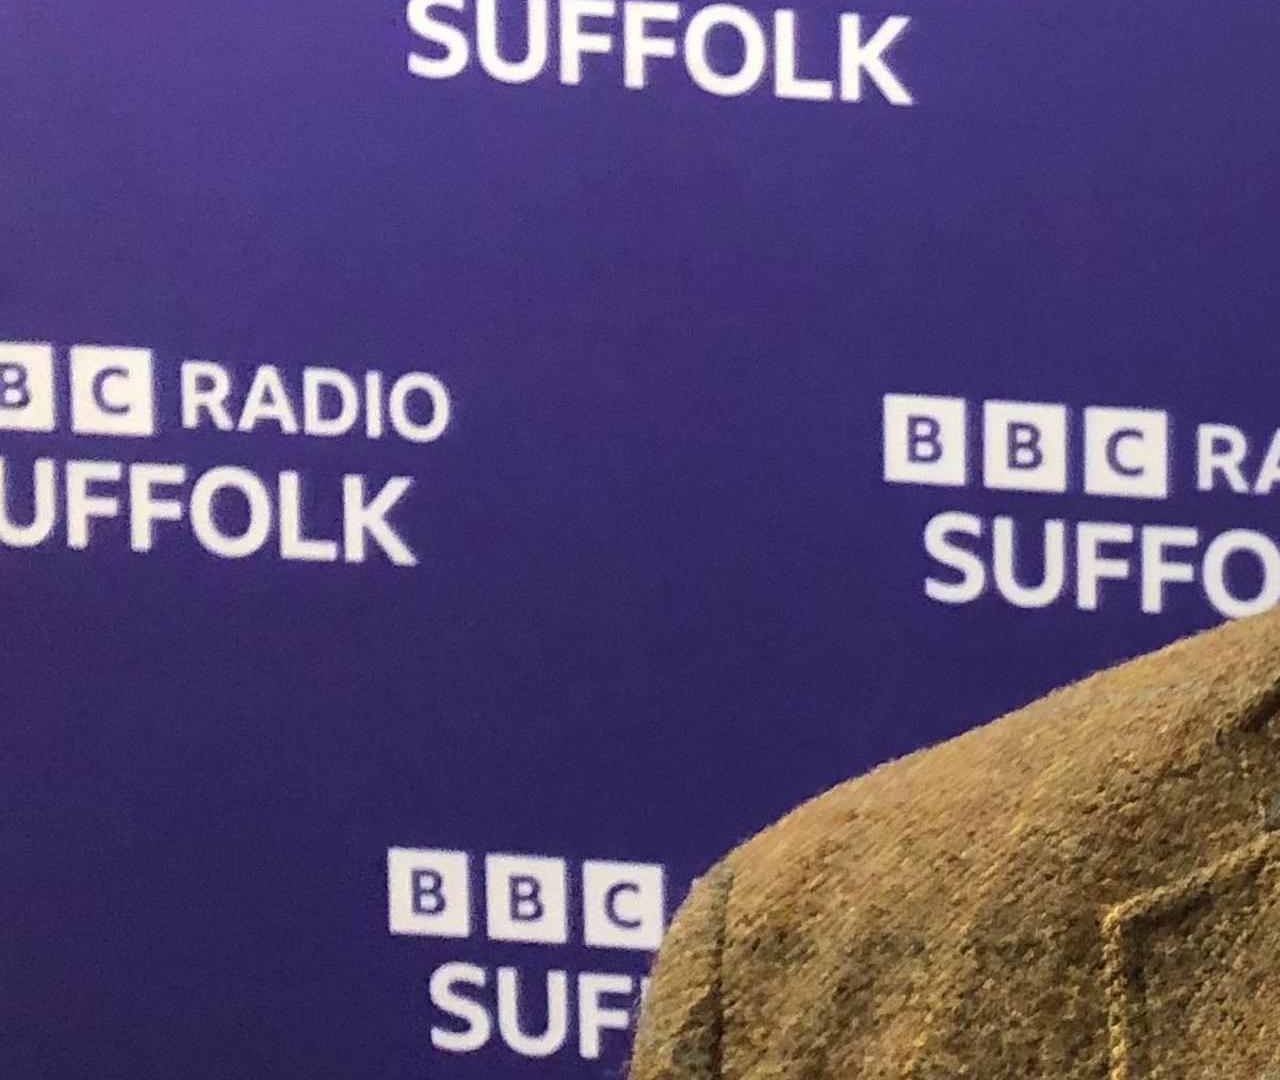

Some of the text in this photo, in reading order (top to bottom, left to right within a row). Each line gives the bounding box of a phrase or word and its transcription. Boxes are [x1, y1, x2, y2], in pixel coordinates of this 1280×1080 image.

[180, 360, 450, 443] RADIO
[883, 394, 1168, 499] BBC
[0, 453, 418, 567] UFFOLK
[387, 846, 665, 950] BBC
